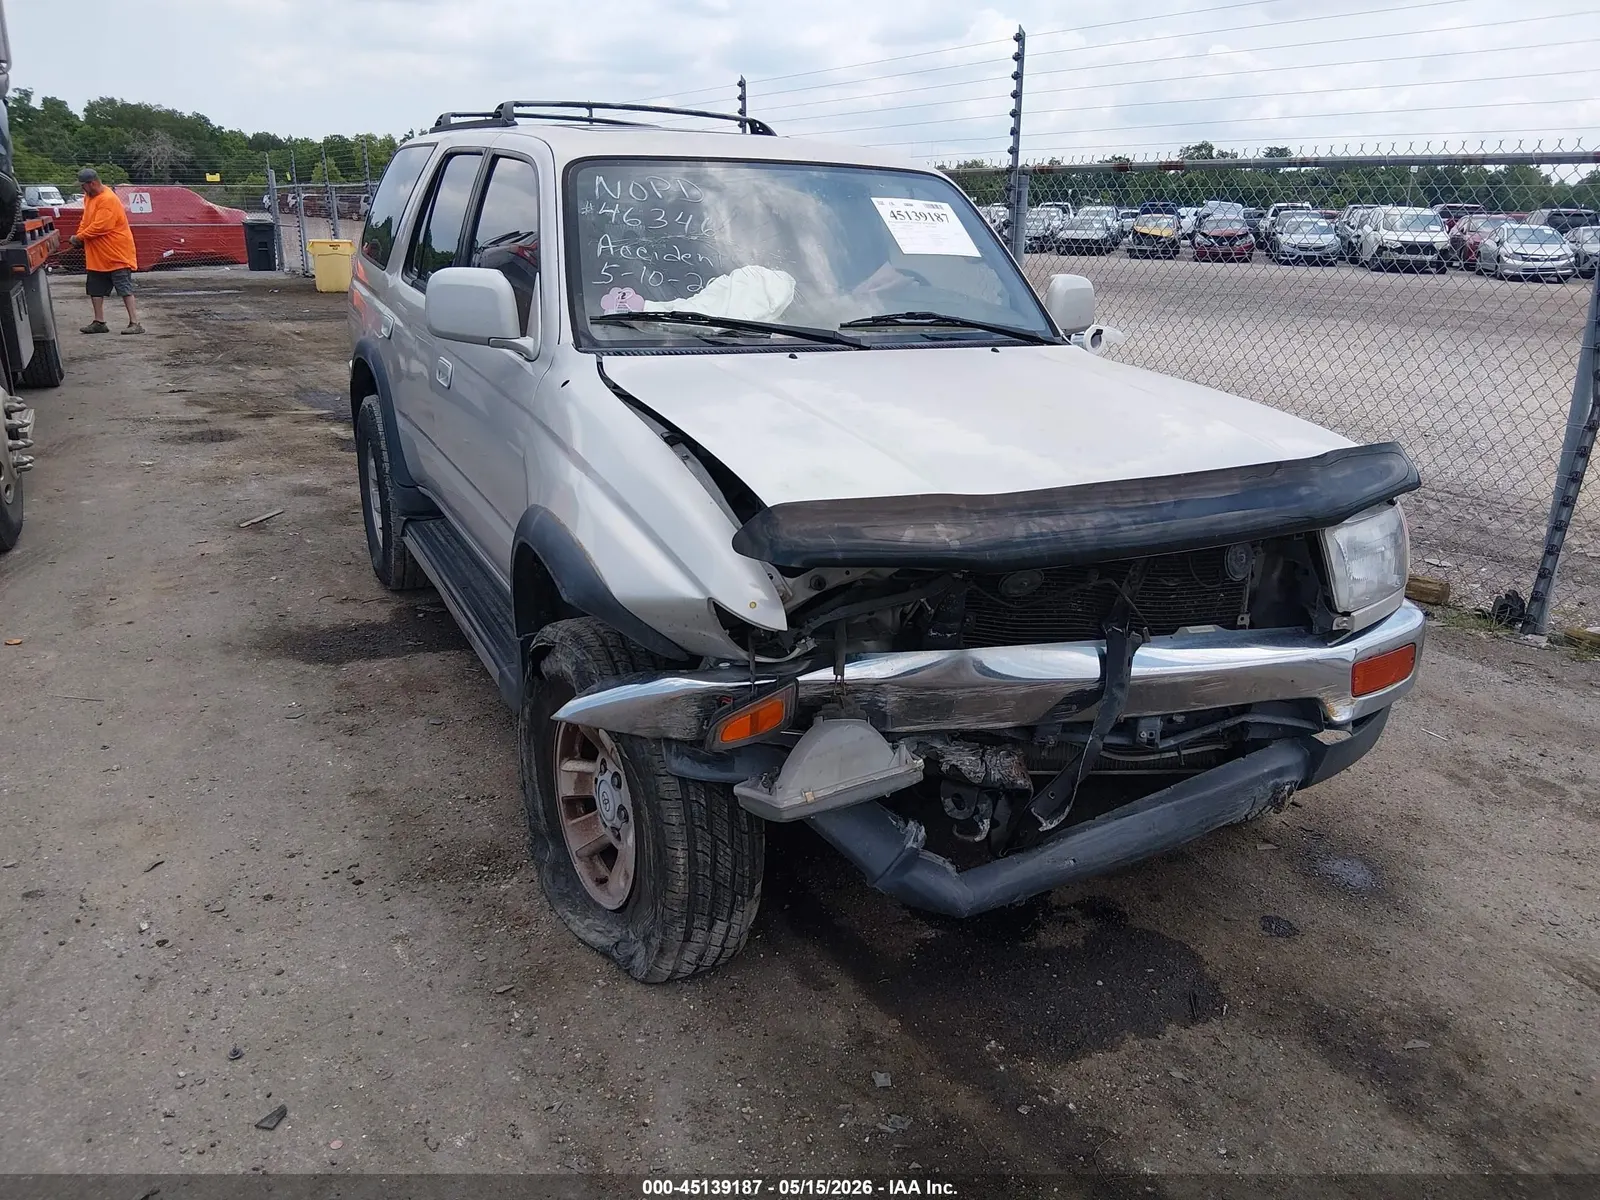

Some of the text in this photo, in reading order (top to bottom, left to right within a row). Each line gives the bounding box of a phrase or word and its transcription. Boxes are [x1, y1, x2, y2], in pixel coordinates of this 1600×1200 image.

[595, 175, 704, 202] NOPD
[890, 210, 949, 223] 45139187
[592, 261, 716, 292] 5-10-2
